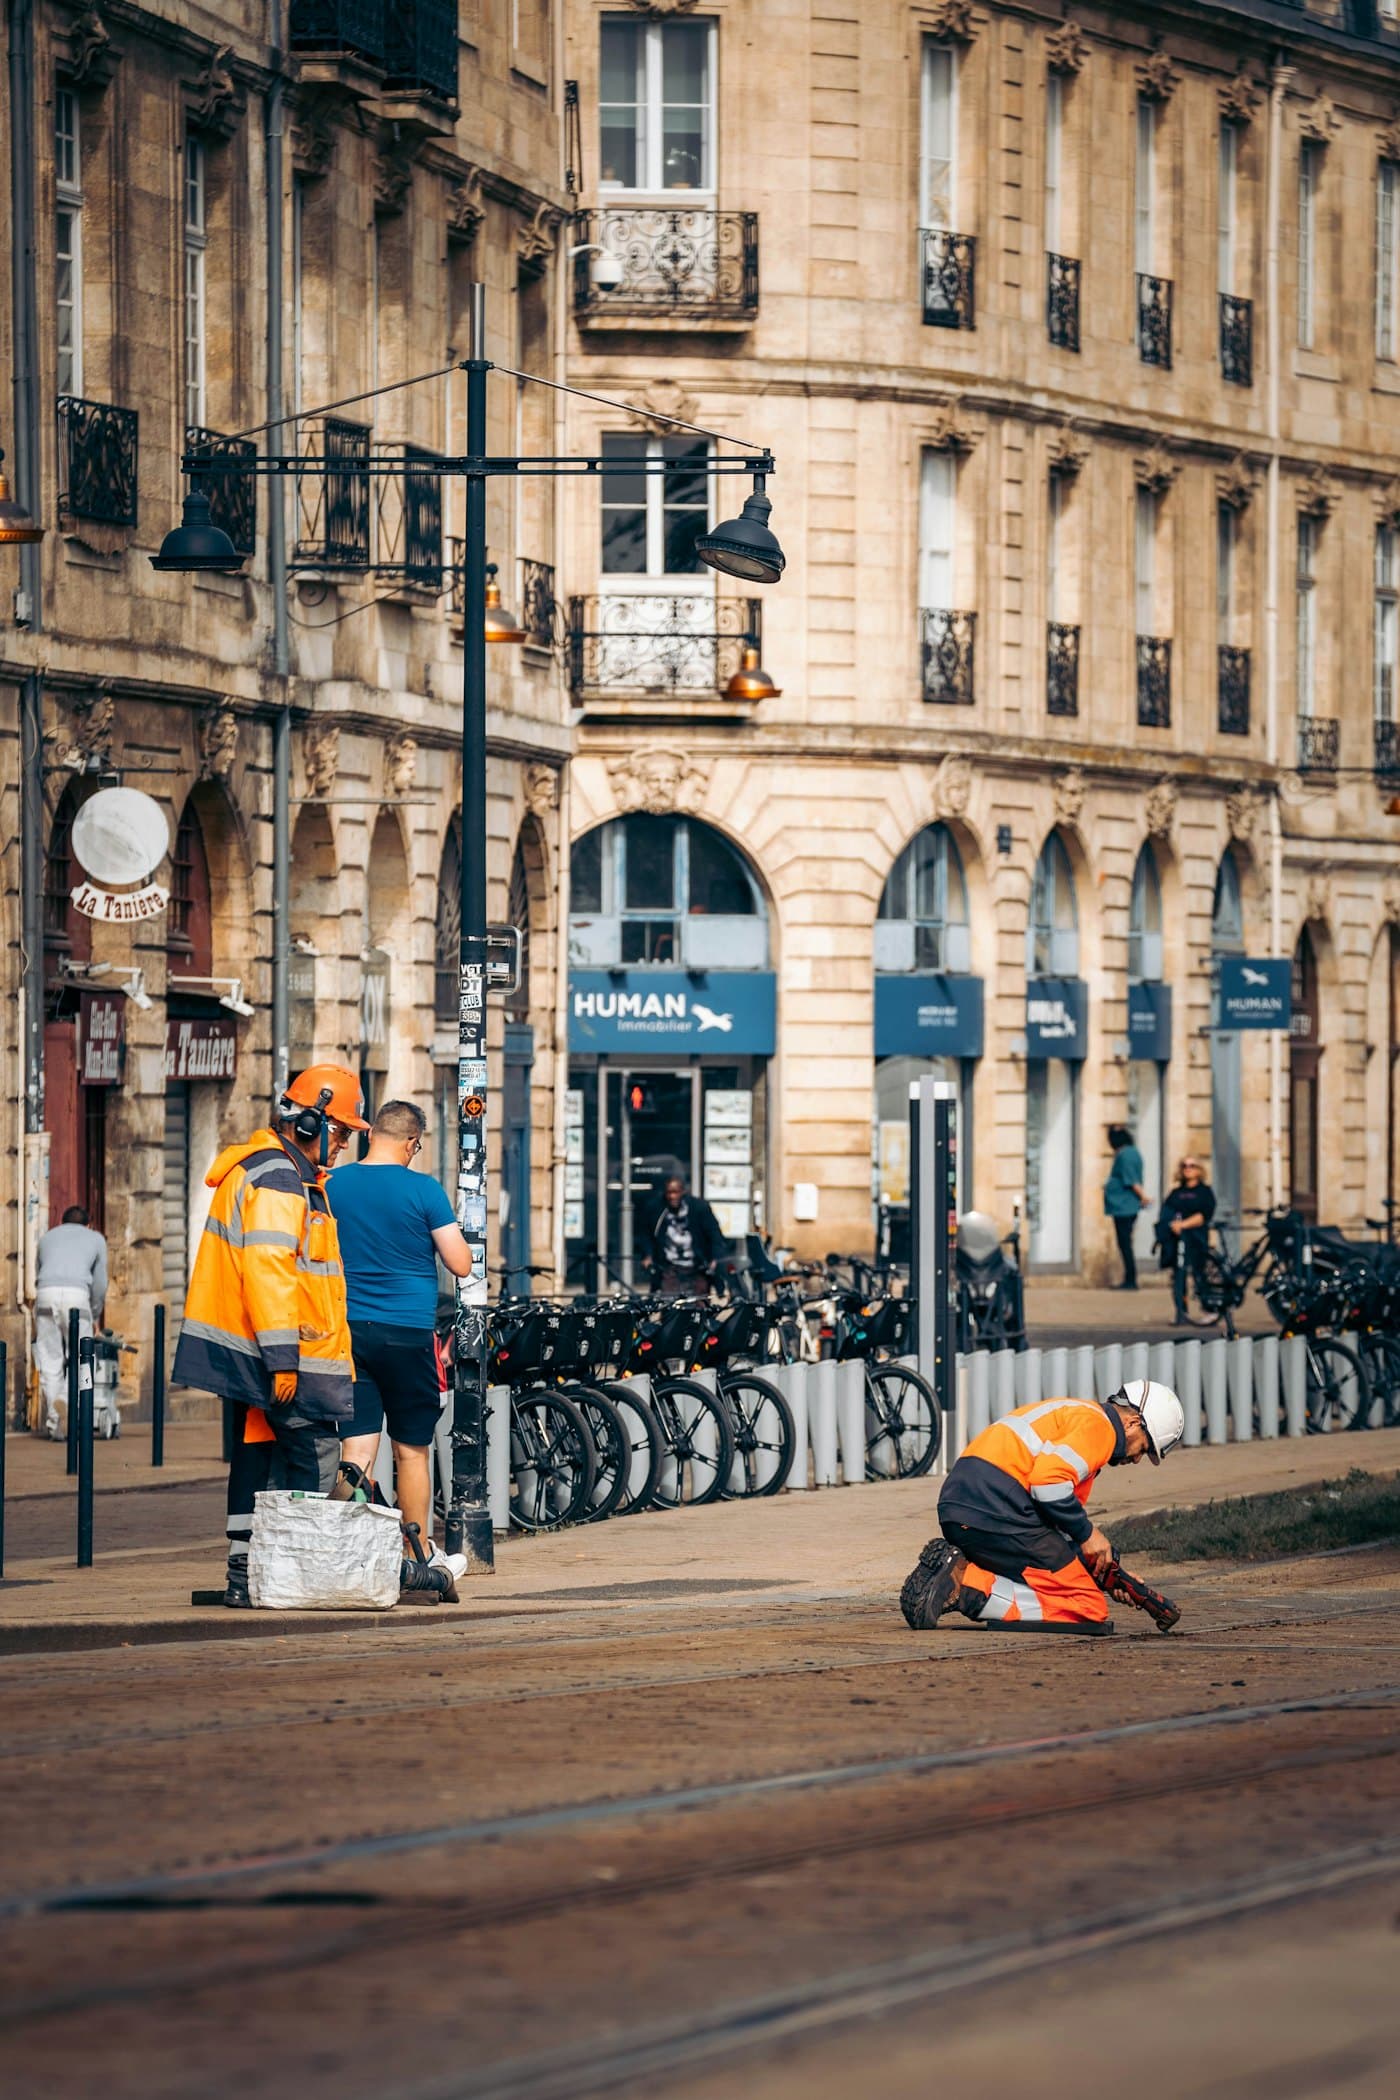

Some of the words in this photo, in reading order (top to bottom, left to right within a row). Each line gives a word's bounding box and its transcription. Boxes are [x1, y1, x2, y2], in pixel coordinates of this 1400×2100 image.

[77, 888, 97, 914] La
[104, 893, 164, 919] Tanière
[574, 993, 686, 1018] HUMAN
[1227, 998, 1283, 1010] HUMAN
[617, 1019, 693, 1033] immobilier
[178, 1023, 236, 1076] Tanière
